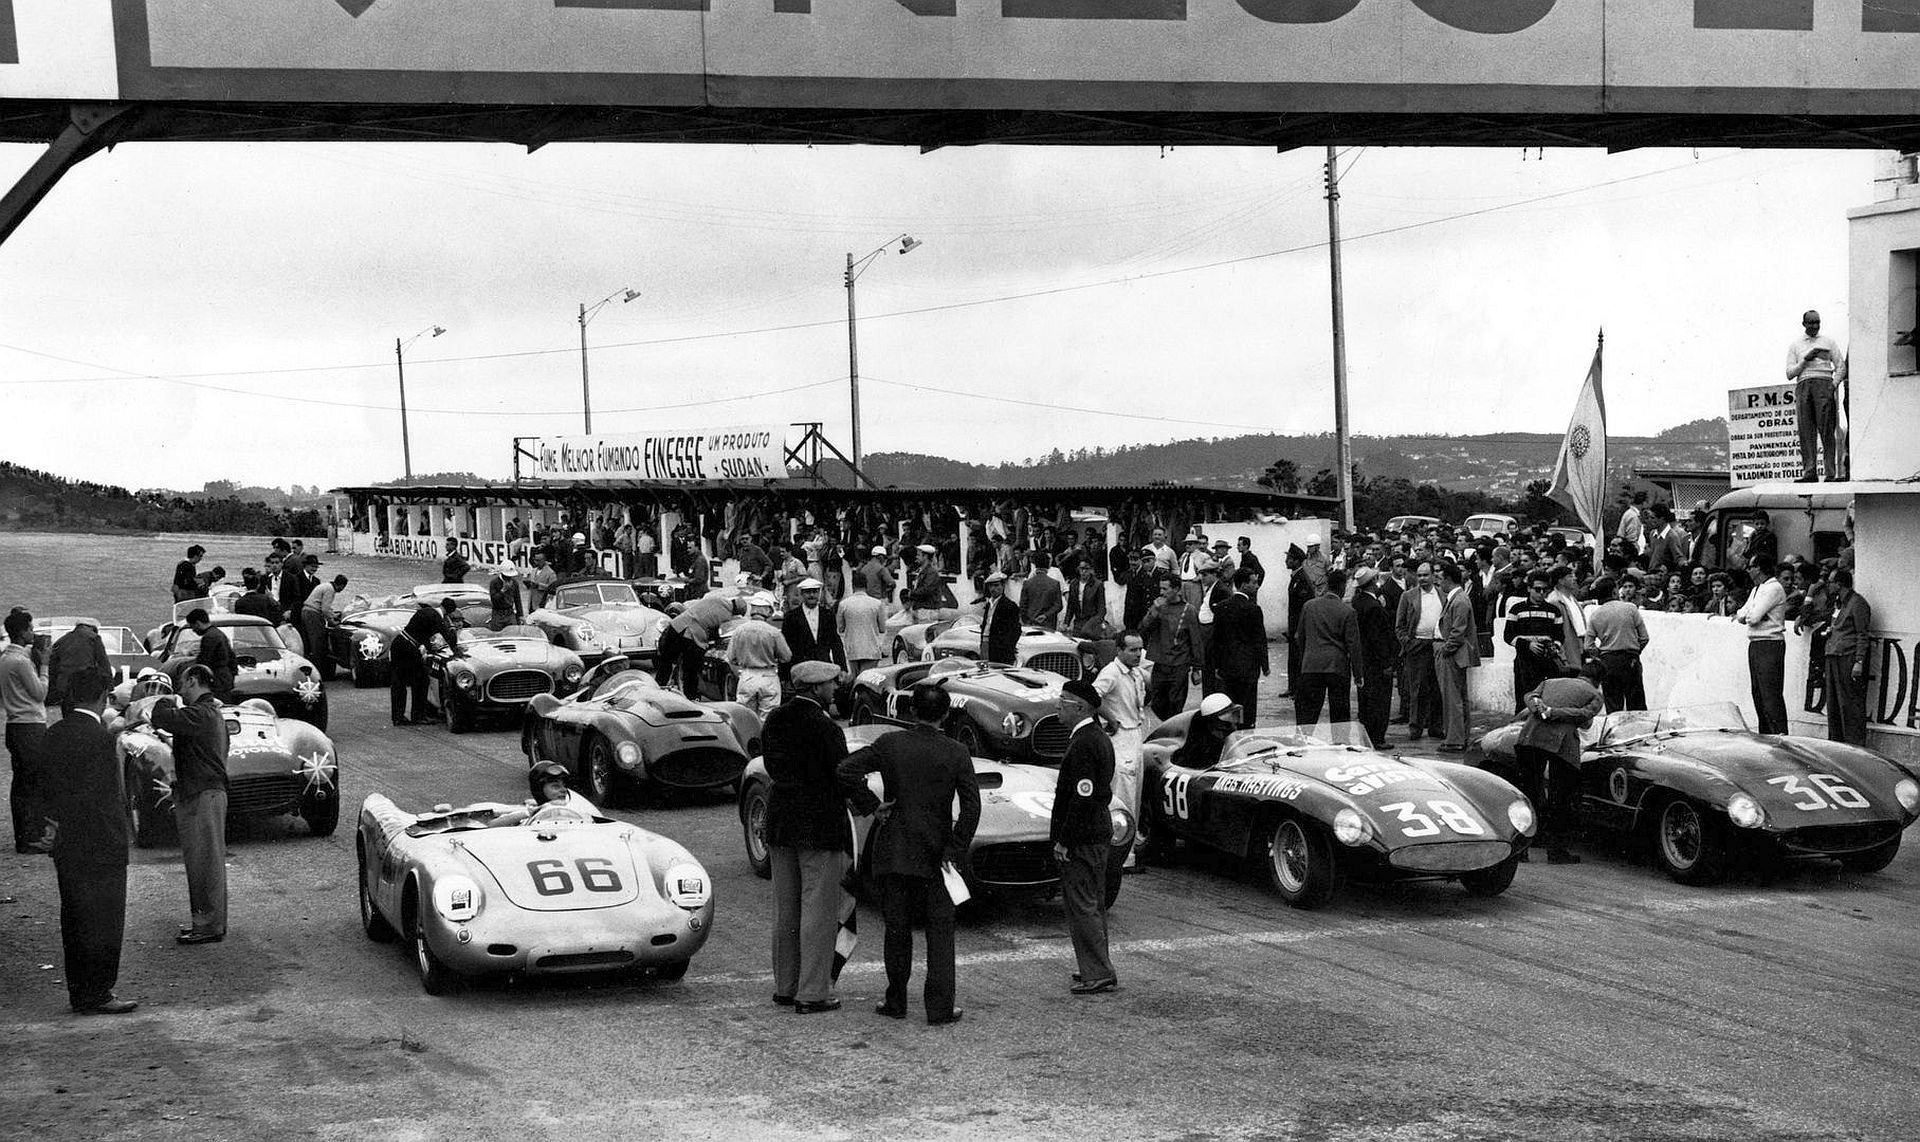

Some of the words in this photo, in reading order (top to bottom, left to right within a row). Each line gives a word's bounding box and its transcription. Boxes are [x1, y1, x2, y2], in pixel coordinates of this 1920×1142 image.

[1758, 417, 1794, 428] OBRAS
[540, 442, 558, 473] FUME
[561, 442, 596, 473] MELHOR
[598, 440, 640, 472] FUMANDO
[644, 436, 706, 479] FINESSE
[708, 435, 721, 451] UM
[722, 431, 770, 450] PRODUTO
[721, 456, 765, 478] SUDAN
[1736, 470, 1773, 480] WLADIMIR
[1163, 771, 1191, 820] 38
[1239, 777, 1304, 800] HASTINGS
[1766, 773, 1871, 811] 36
[1379, 800, 1485, 838] 38
[526, 858, 623, 896] 66
